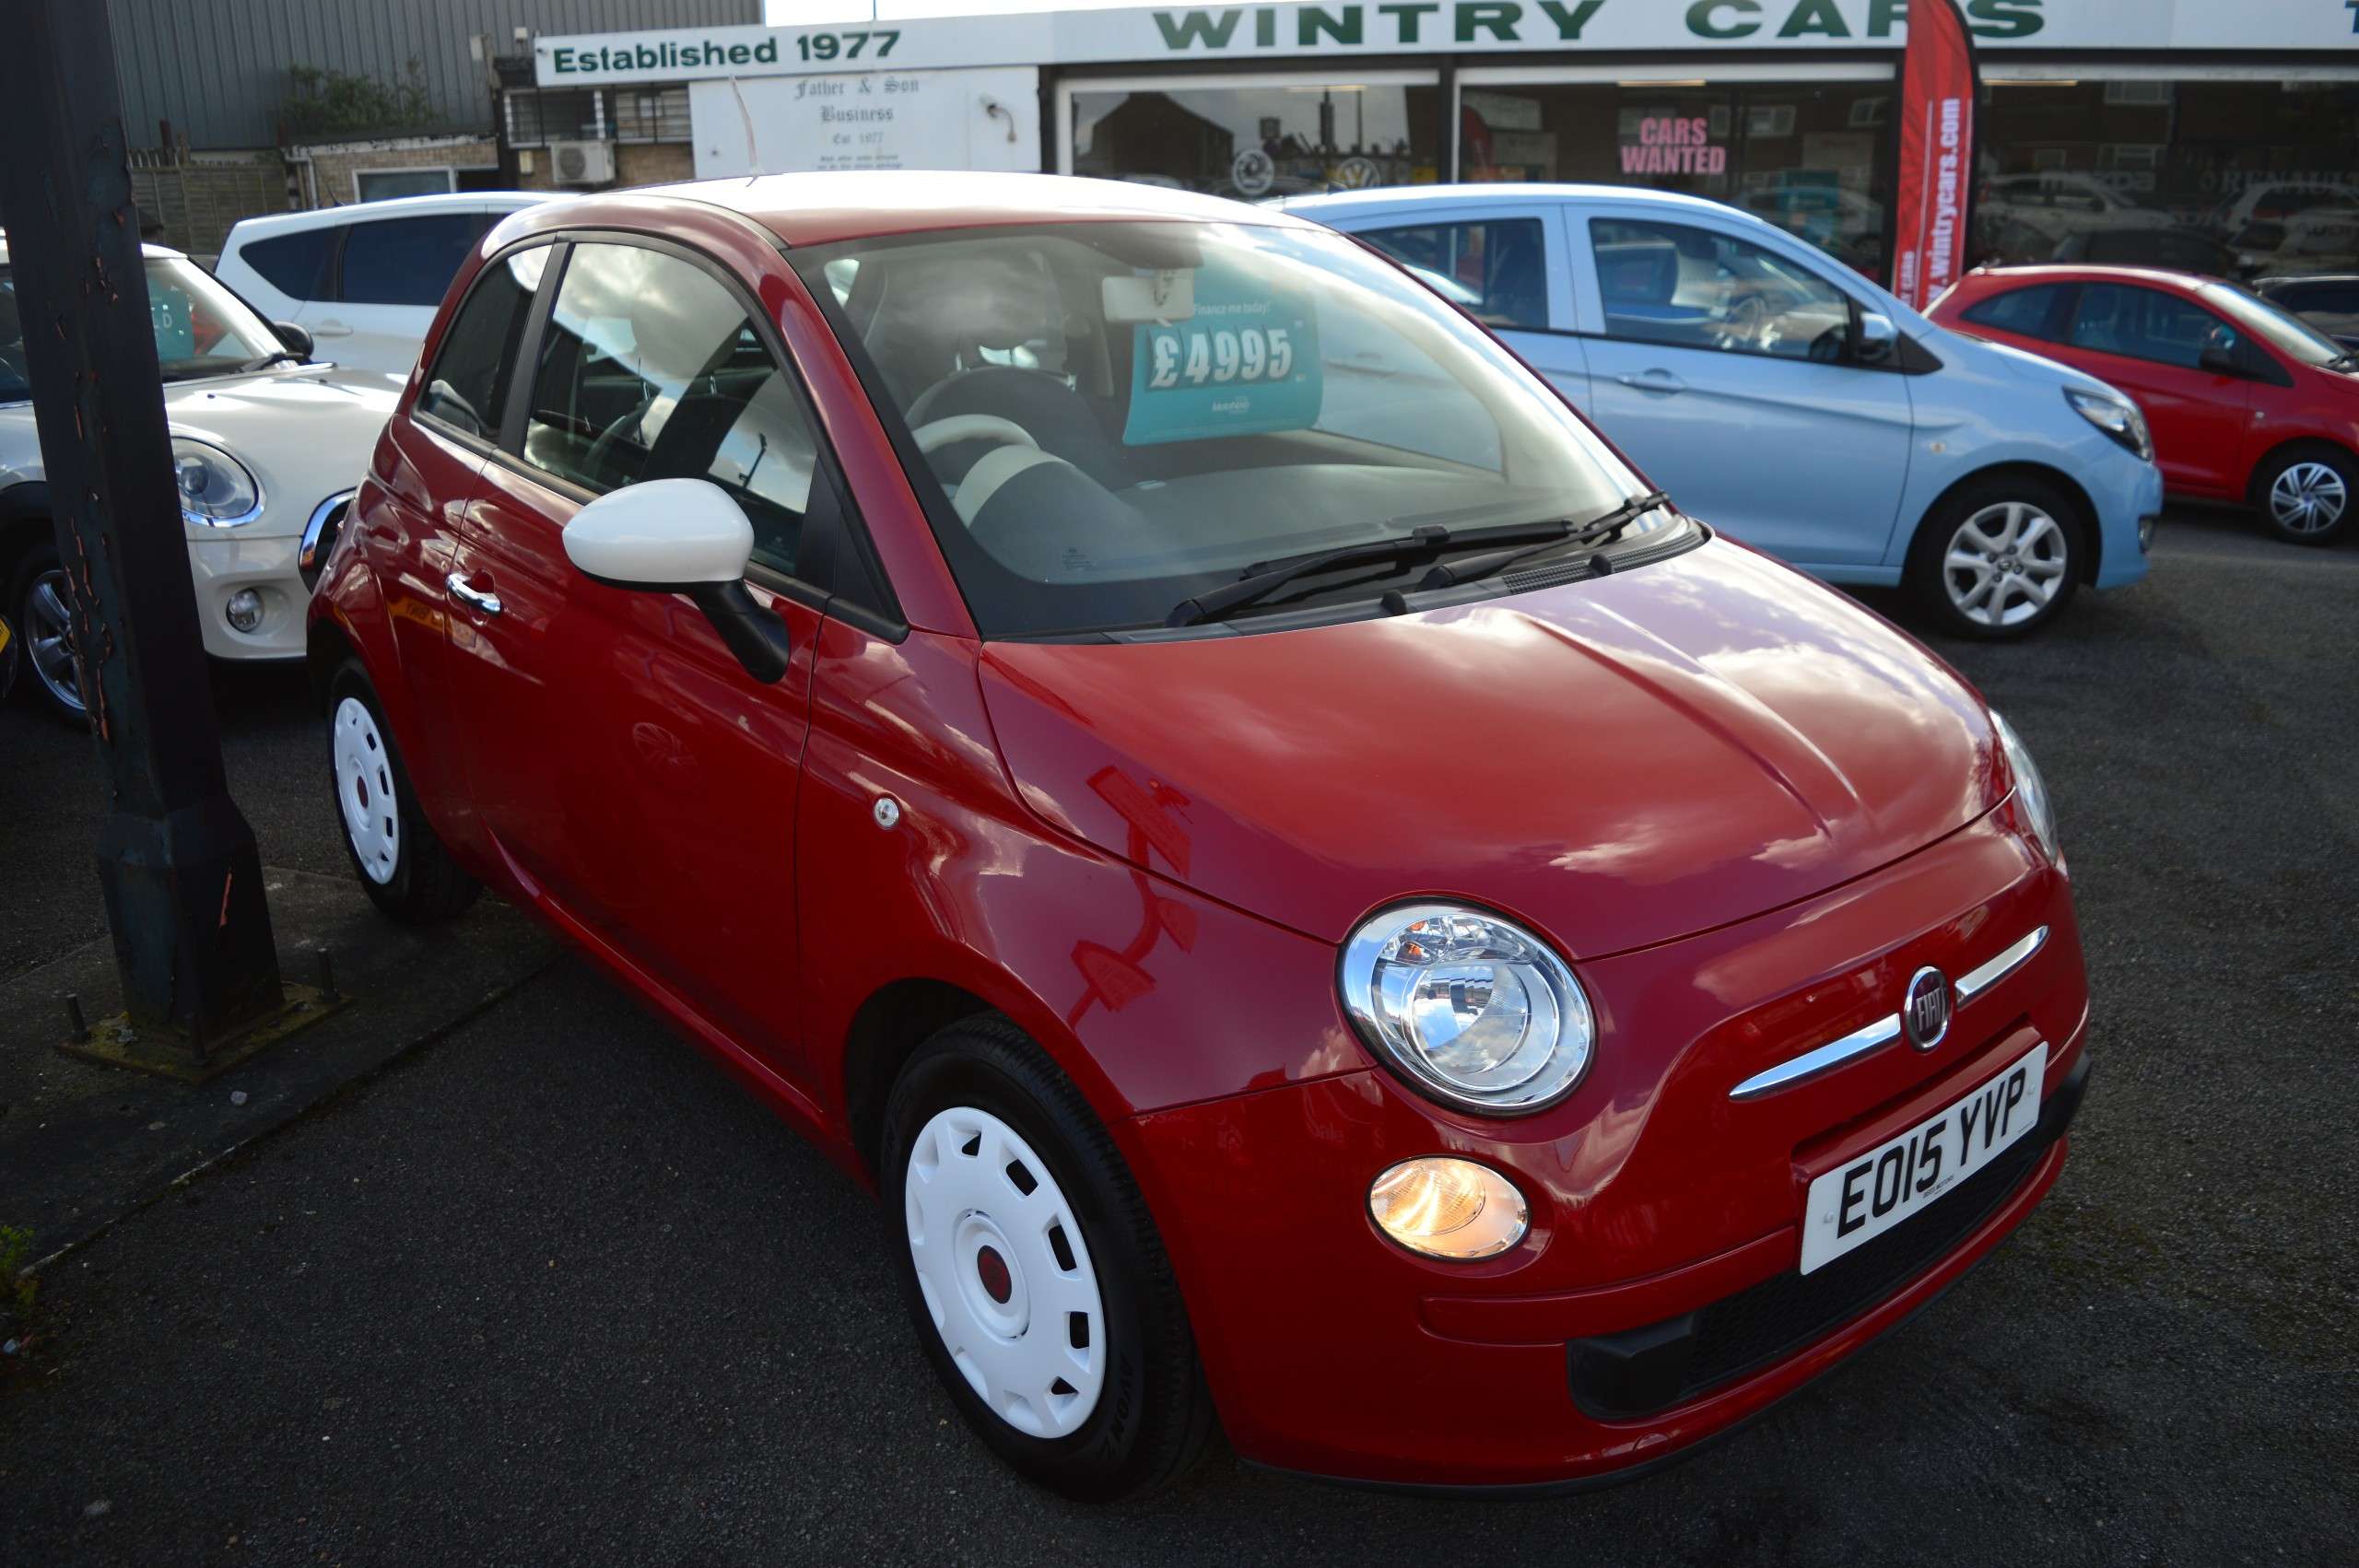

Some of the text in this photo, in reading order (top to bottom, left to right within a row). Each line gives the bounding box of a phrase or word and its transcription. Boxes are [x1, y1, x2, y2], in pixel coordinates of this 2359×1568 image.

[1151, 0, 1606, 51] WINTRY
[553, 29, 901, 74] Established 1977
[794, 76, 920, 100] Father & Son
[819, 105, 895, 123] Business
[1640, 117, 1708, 145] CARS
[1622, 146, 1725, 174] WANTED
[1150, 328, 1292, 388] £4995
[1916, 987, 1946, 1032] FIAT
[1837, 1066, 2026, 1239] EO15 YVP
